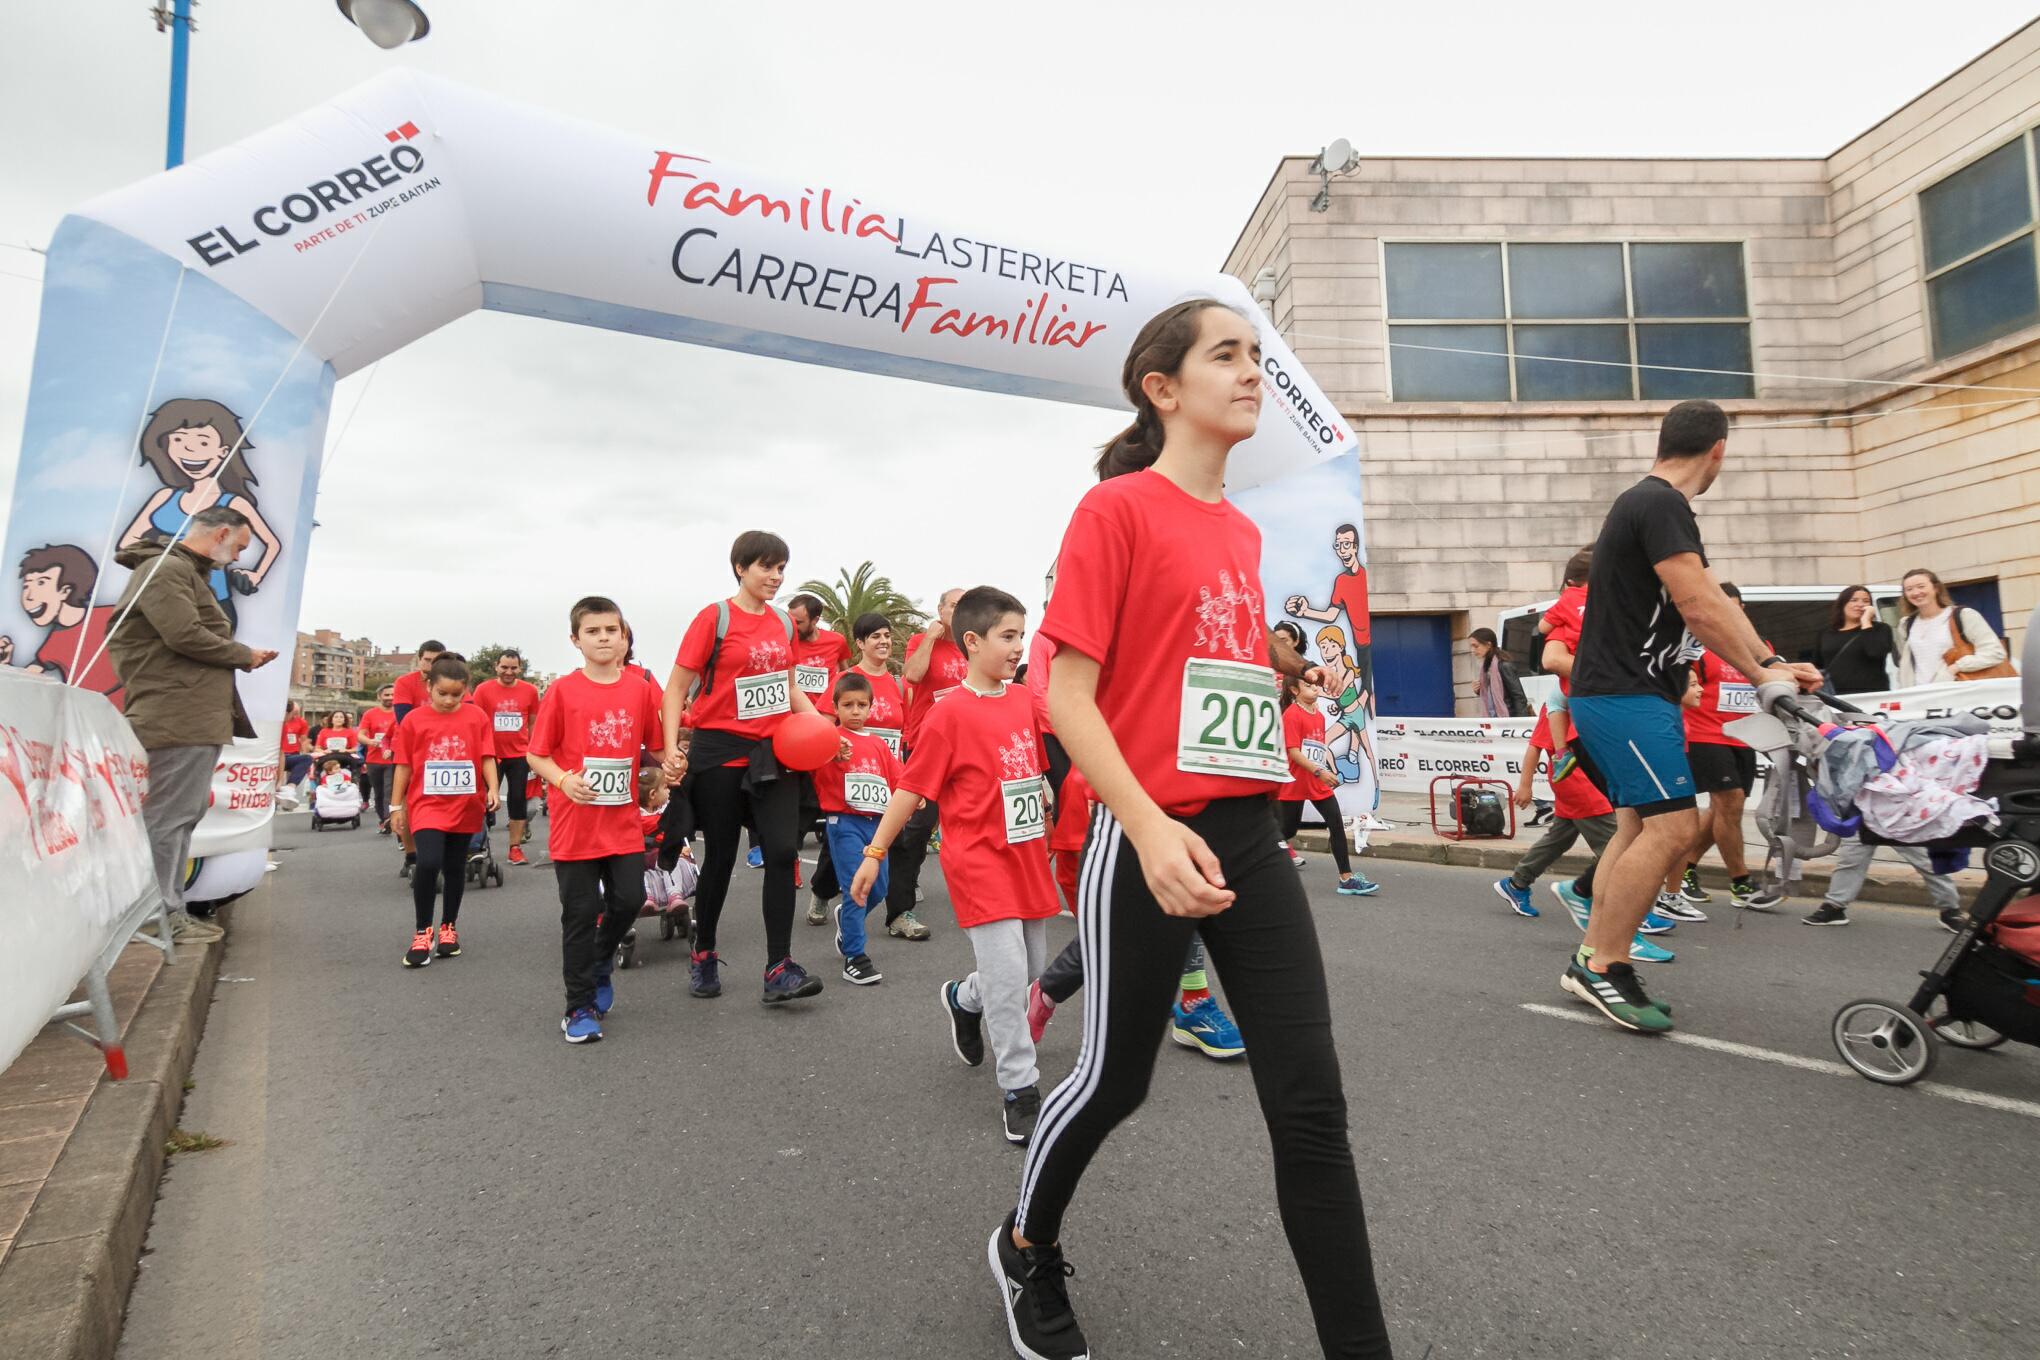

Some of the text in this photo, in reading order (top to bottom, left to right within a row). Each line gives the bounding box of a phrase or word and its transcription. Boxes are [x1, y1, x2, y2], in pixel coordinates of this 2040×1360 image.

[186, 145, 424, 267] EL CORREO
[293, 227, 336, 253] PARTE
[334, 219, 353, 233] DE
[352, 212, 368, 225] TI
[398, 176, 441, 203] BAITAN
[648, 150, 1129, 303] Familia LASTERKETA
[671, 227, 1107, 349] CARRERA Familiar
[1264, 357, 1334, 444] CORREO
[797, 672, 825, 687] 2060
[744, 683, 786, 709] 2033
[498, 717, 520, 729] 1013
[431, 770, 472, 786] 1013
[1418, 759, 1490, 773] EL CORREO
[851, 783, 888, 804] 2033
